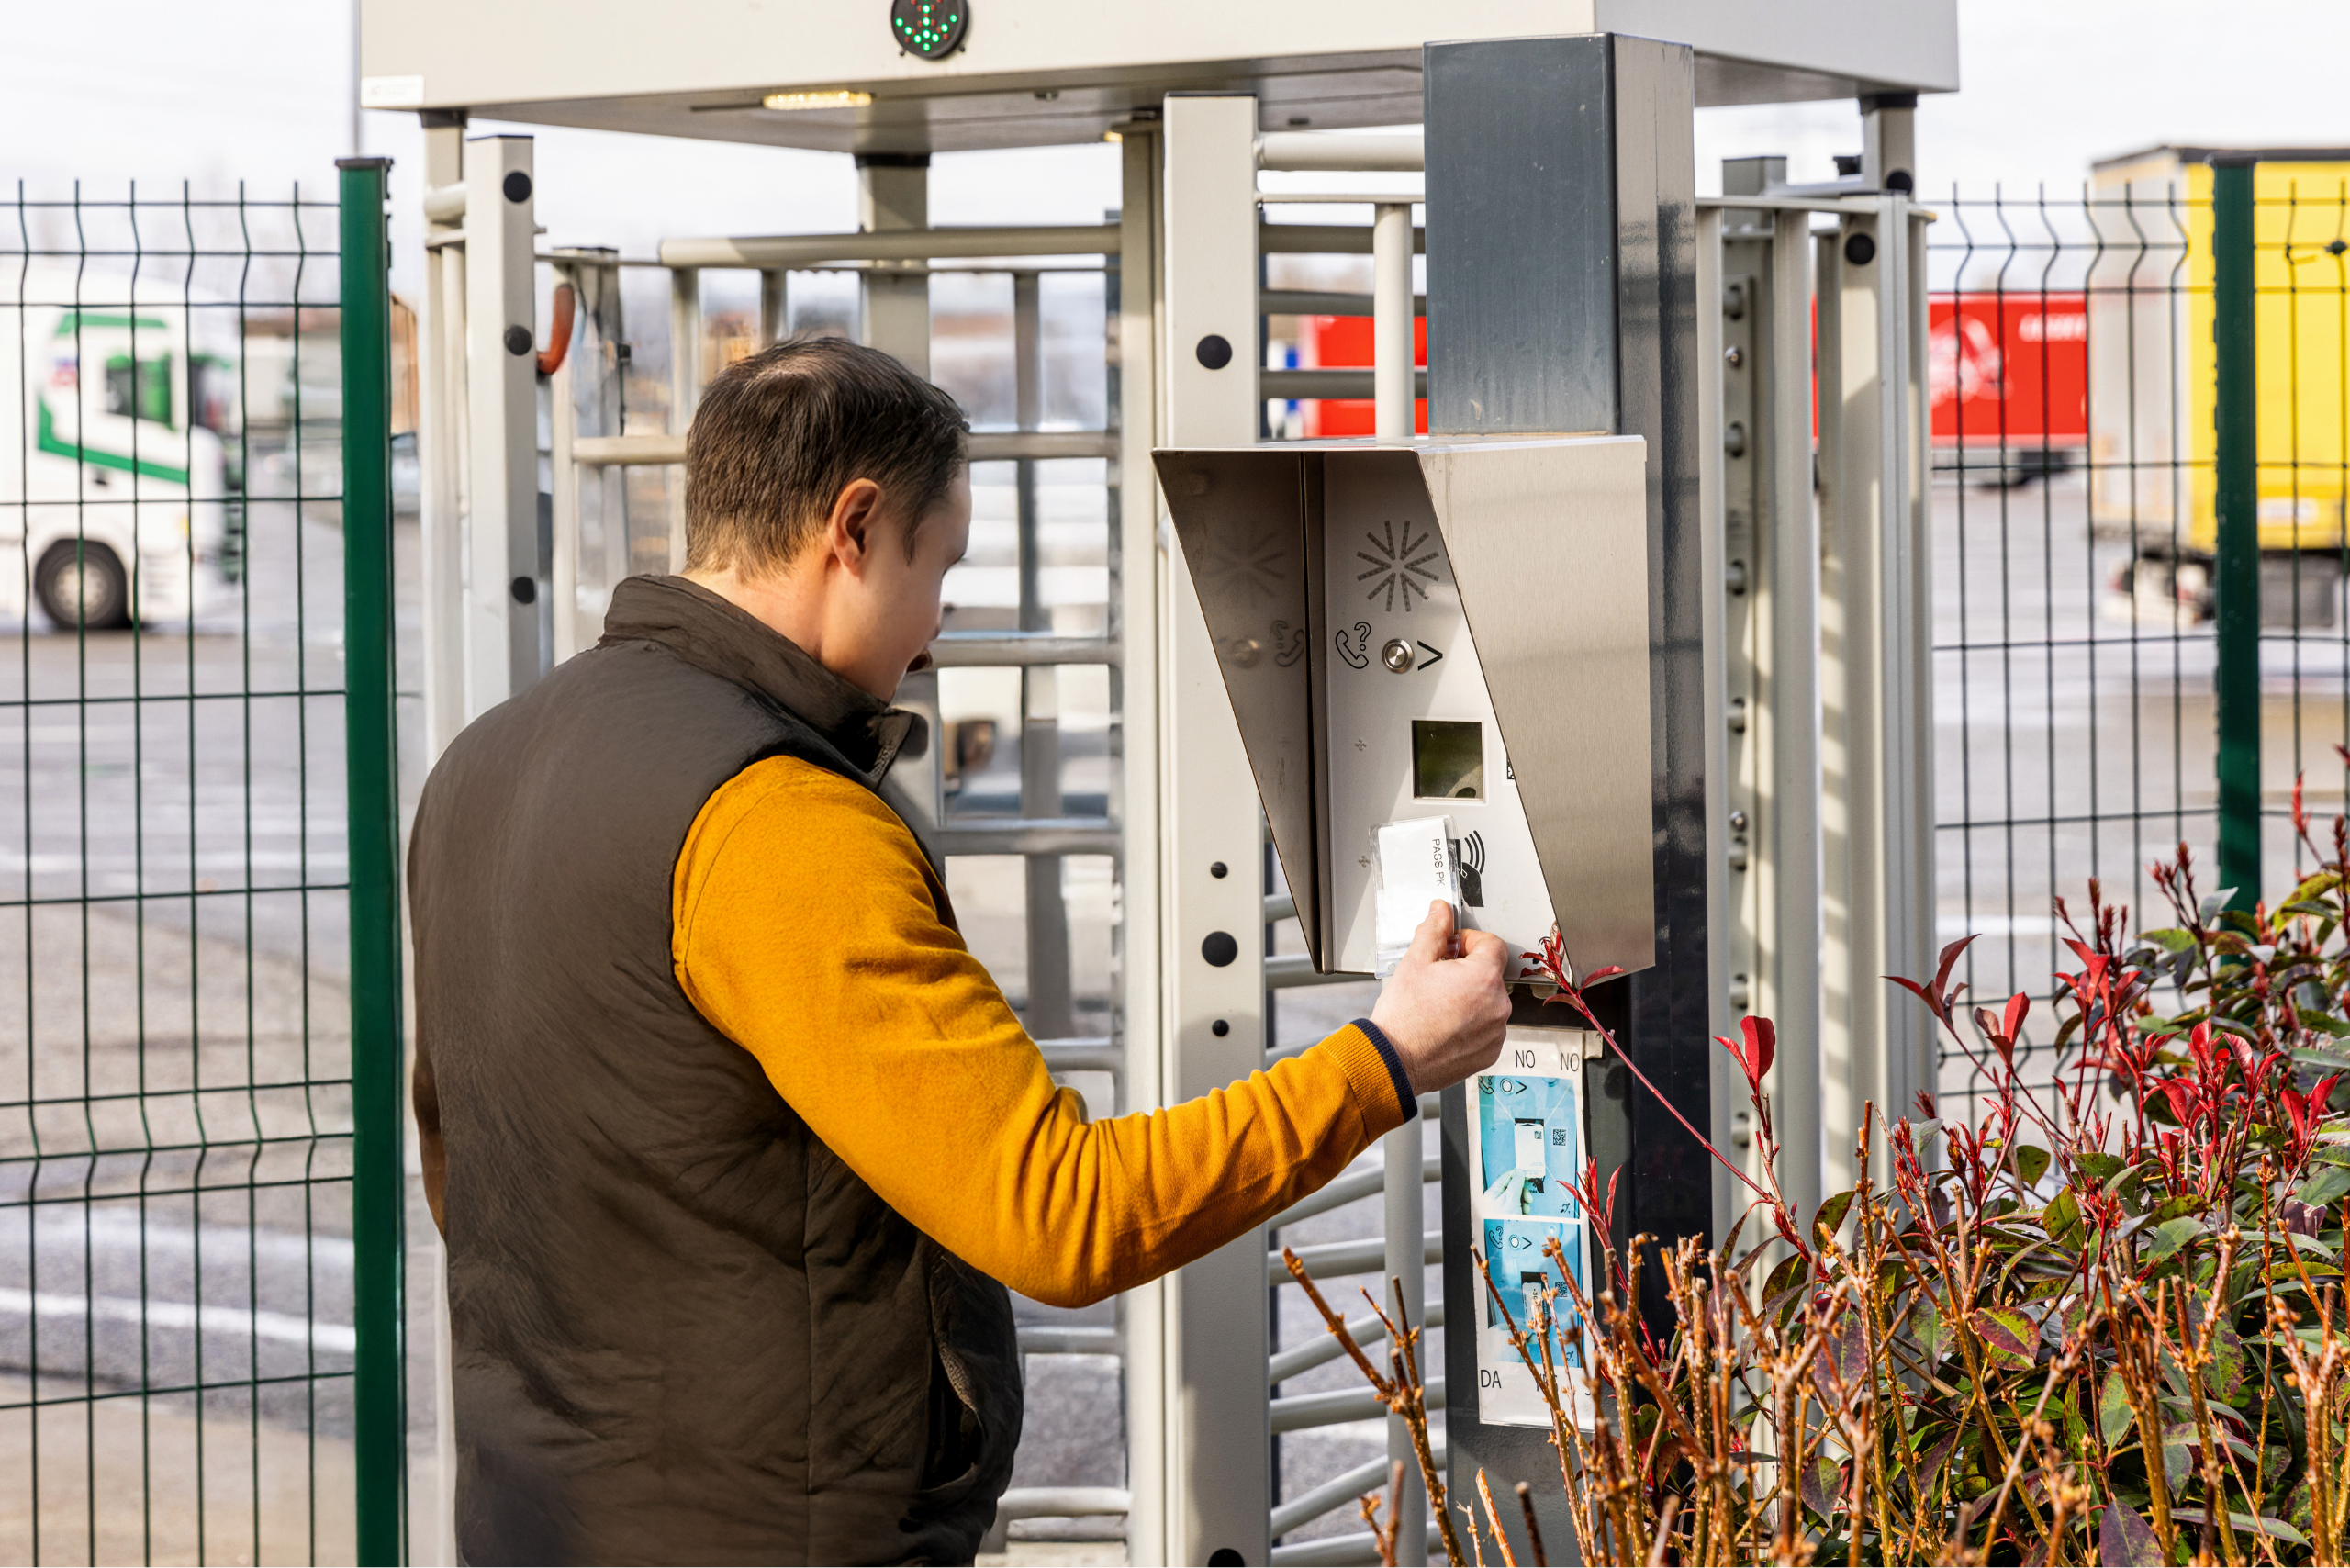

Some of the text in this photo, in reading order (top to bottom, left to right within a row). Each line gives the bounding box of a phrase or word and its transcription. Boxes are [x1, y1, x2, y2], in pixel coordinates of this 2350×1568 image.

[1432, 838, 1446, 887] PASS PK
[1515, 1049, 1580, 1072] NO NO
[1480, 1369, 1502, 1389] DA
